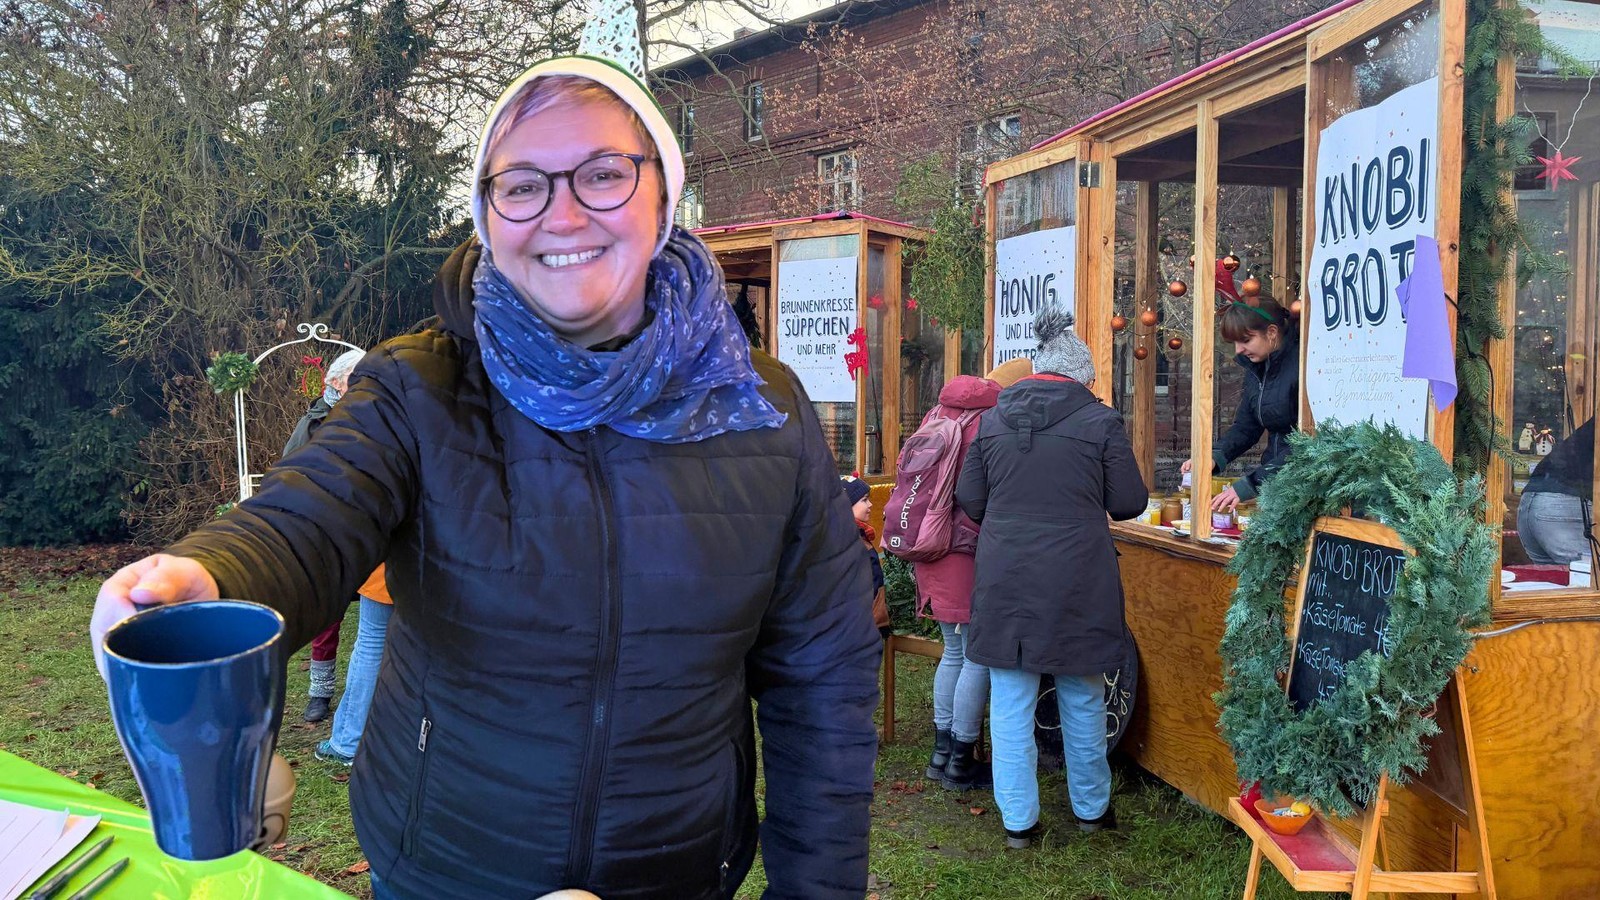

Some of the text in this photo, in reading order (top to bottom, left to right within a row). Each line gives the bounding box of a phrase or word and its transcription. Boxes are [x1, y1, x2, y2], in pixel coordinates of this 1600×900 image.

[1320, 138, 1430, 248] KNOBI
[781, 297, 854, 314] BRUNNENKRESSE
[1001, 273, 1057, 318] HONIG
[784, 315, 850, 337] SÜPPCHEN
[1005, 322, 1022, 340] UND
[796, 343, 837, 356] UND MEHR
[900, 474, 923, 529] ORTOVOX
[1315, 538, 1407, 598] KNOBI BROT
